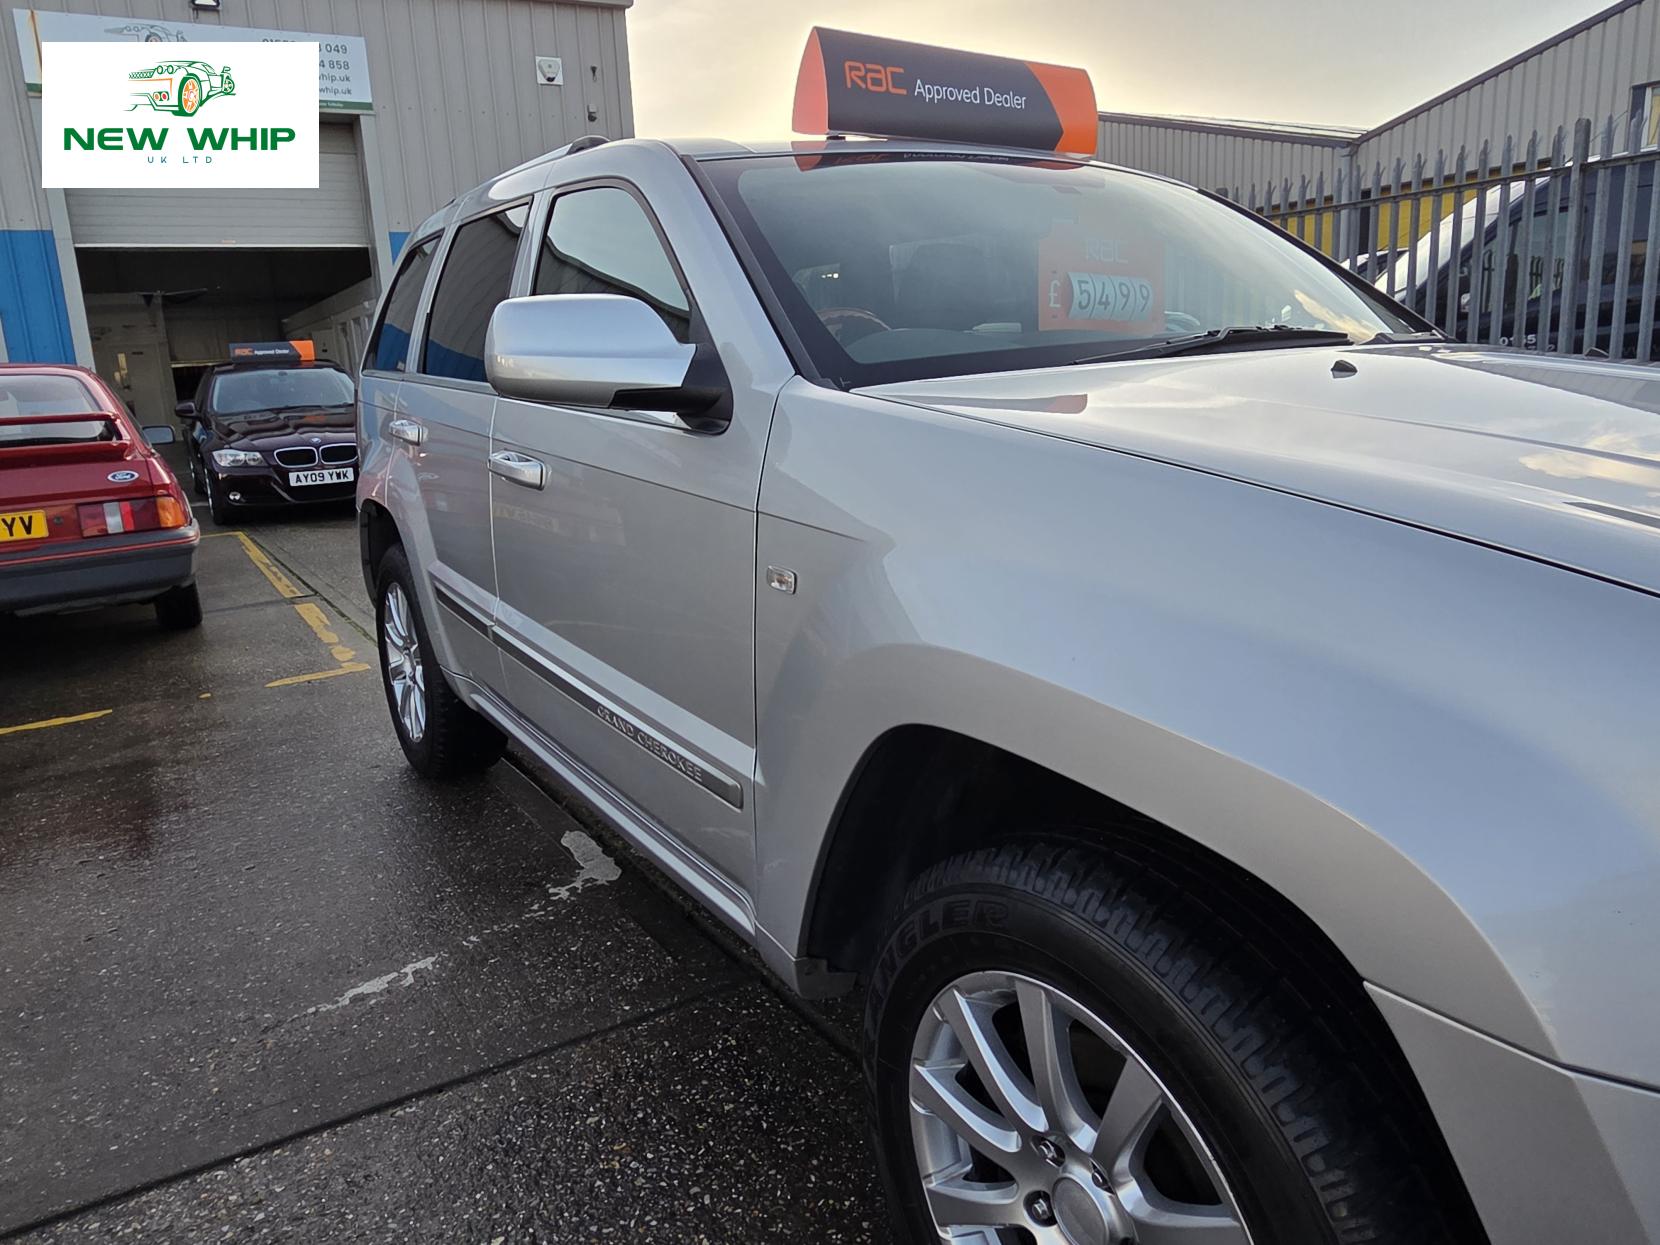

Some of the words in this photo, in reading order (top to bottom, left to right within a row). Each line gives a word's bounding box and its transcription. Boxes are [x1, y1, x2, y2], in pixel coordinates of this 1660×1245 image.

[325, 43, 347, 54] 049
[328, 60, 350, 70] 858
[914, 79, 980, 104] Approved
[984, 87, 1026, 109] Dealer
[1077, 279, 1150, 313] 5499
[295, 472, 325, 484] AY09
[1, 515, 33, 537] YV
[597, 705, 635, 737] GRAND
[637, 731, 703, 783] CHEROKEE
